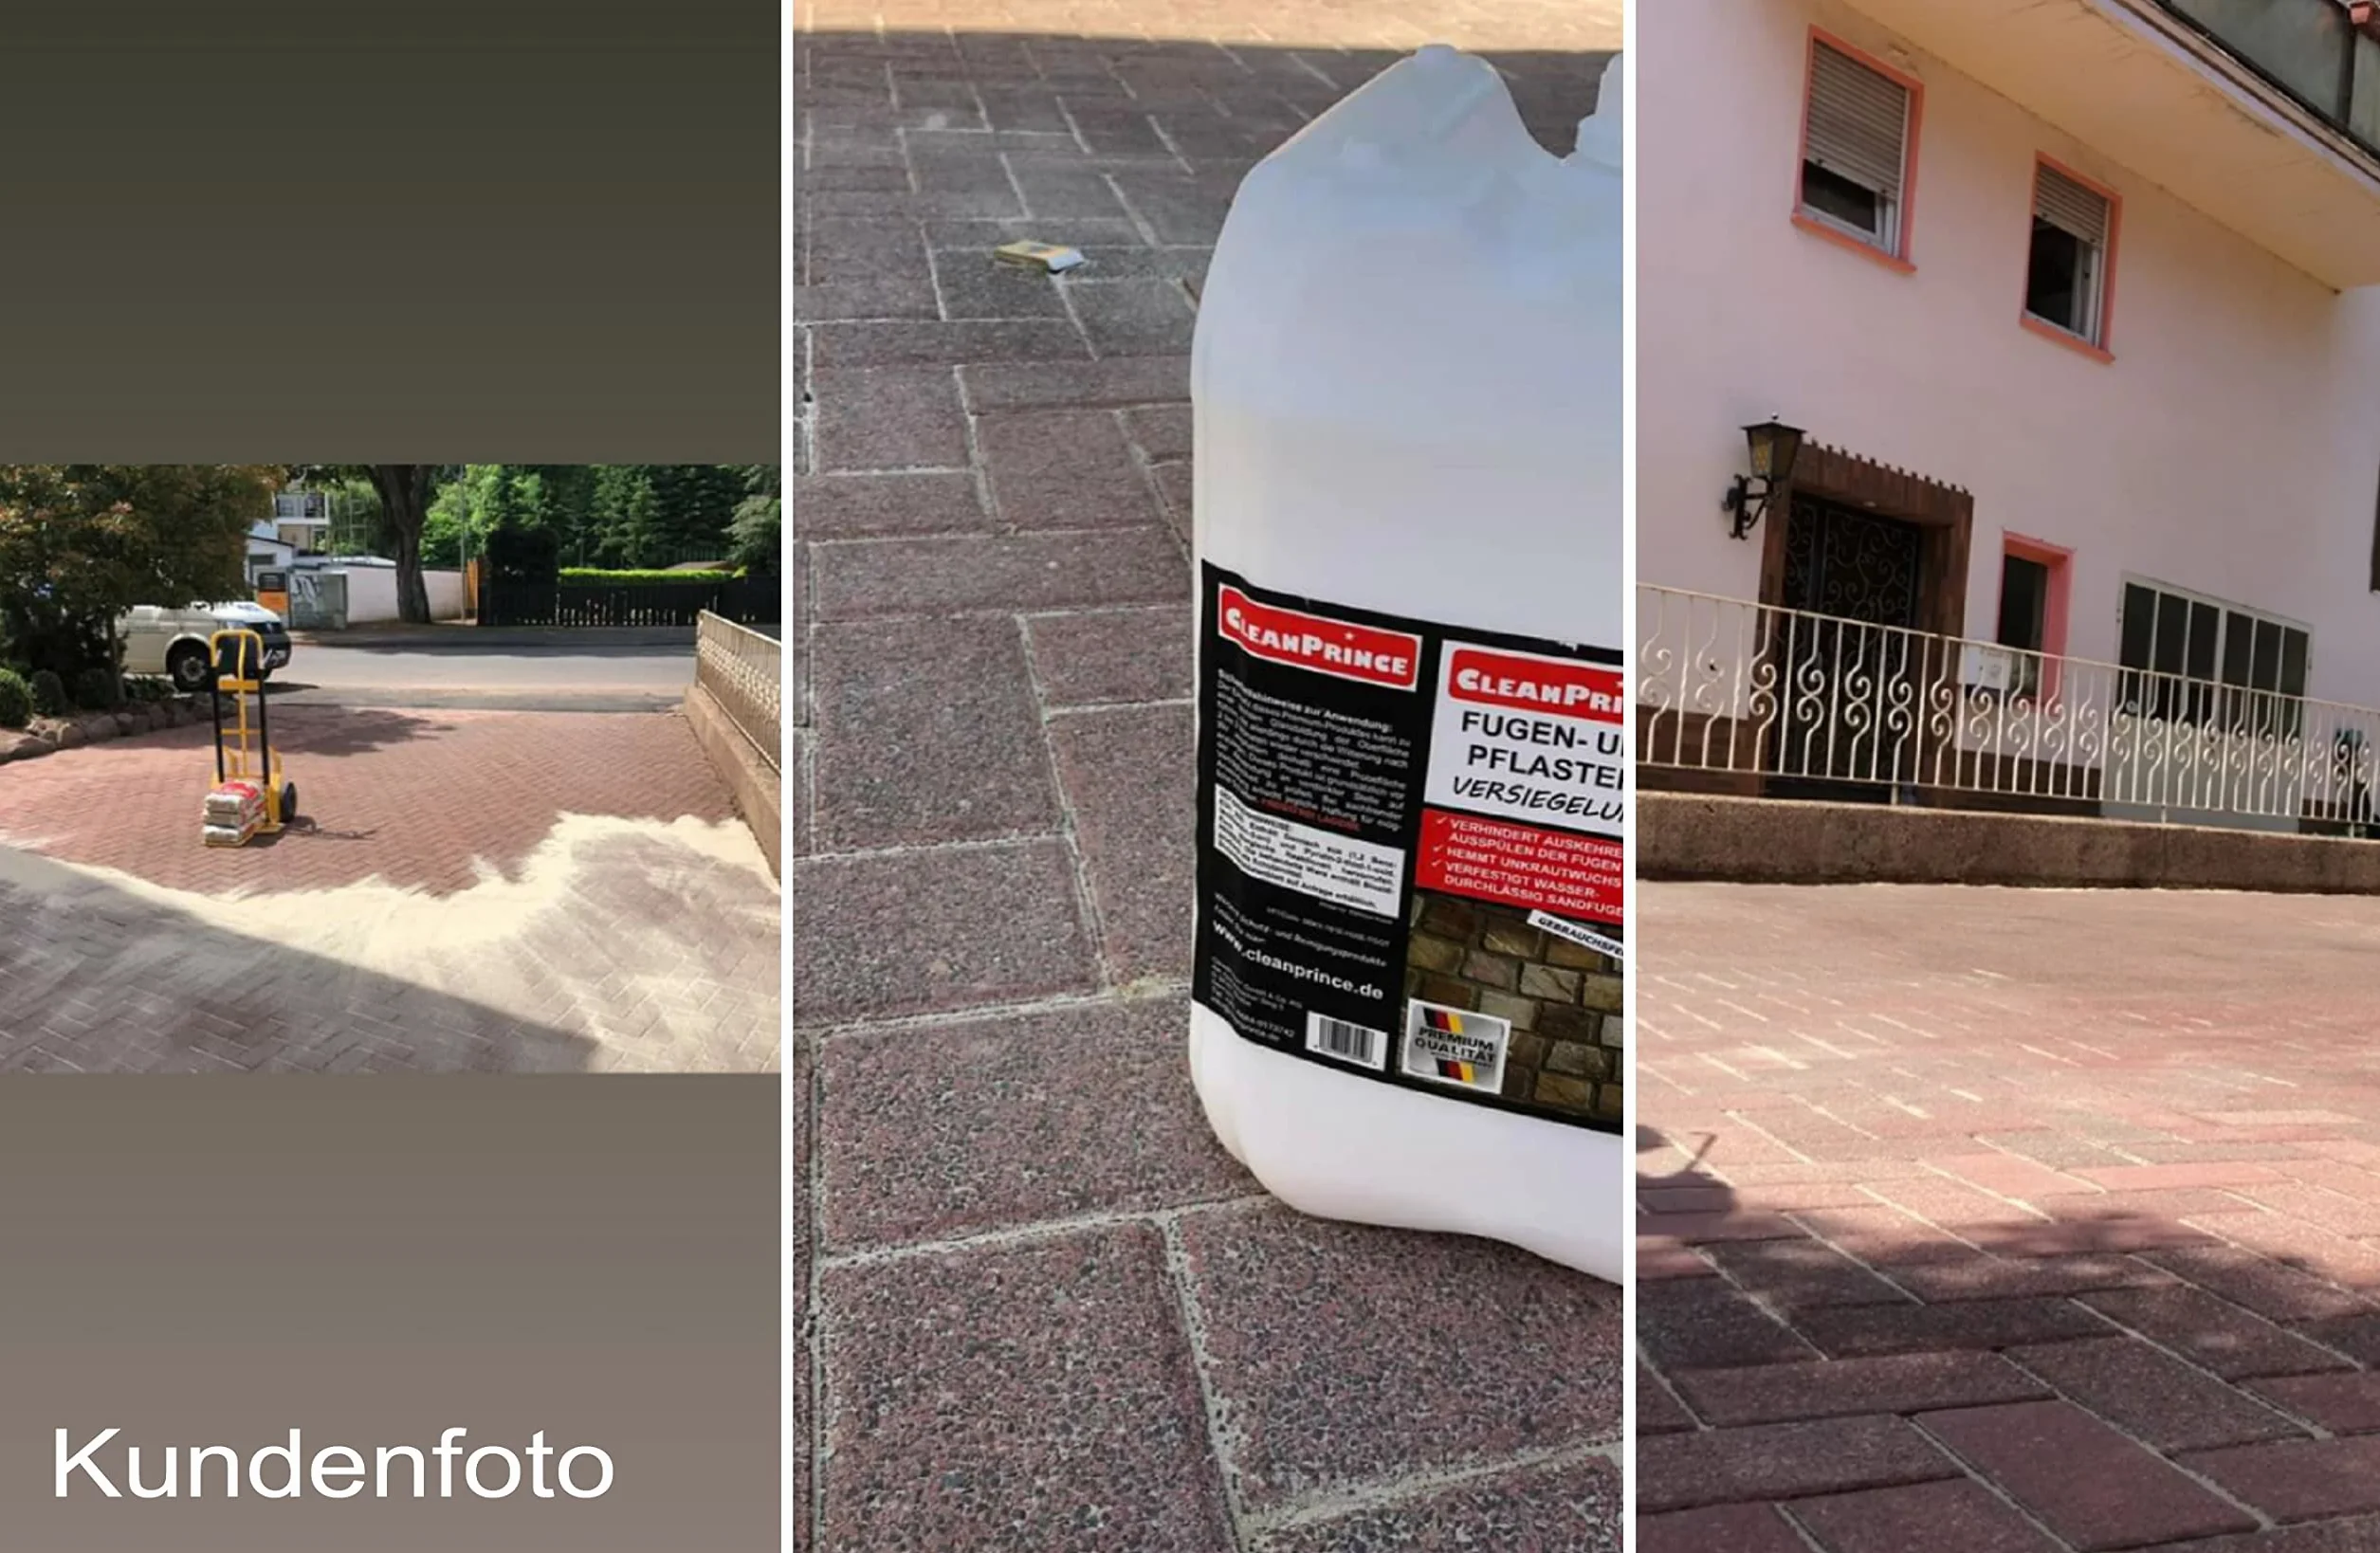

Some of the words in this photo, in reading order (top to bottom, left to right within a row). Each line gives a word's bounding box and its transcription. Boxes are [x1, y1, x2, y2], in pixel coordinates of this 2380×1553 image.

[1225, 607, 1409, 676] CLEANPRINCE
[1461, 710, 1588, 749] FUGEN-
[1597, 730, 1623, 758] U
[1453, 775, 1623, 823] VERSIEGELU
[1450, 817, 1539, 844] VERHINDERT
[1445, 861, 1531, 886] VERFESTIGT
[1533, 877, 1601, 899] WASSER-
[1446, 846, 1496, 865] HEMMT
[1499, 856, 1622, 888] UNKRAUTWUCHS
[1537, 847, 1567, 863] DER
[1570, 852, 1622, 872] FUGEN
[1212, 919, 1384, 1000] www.cleanprince.de
